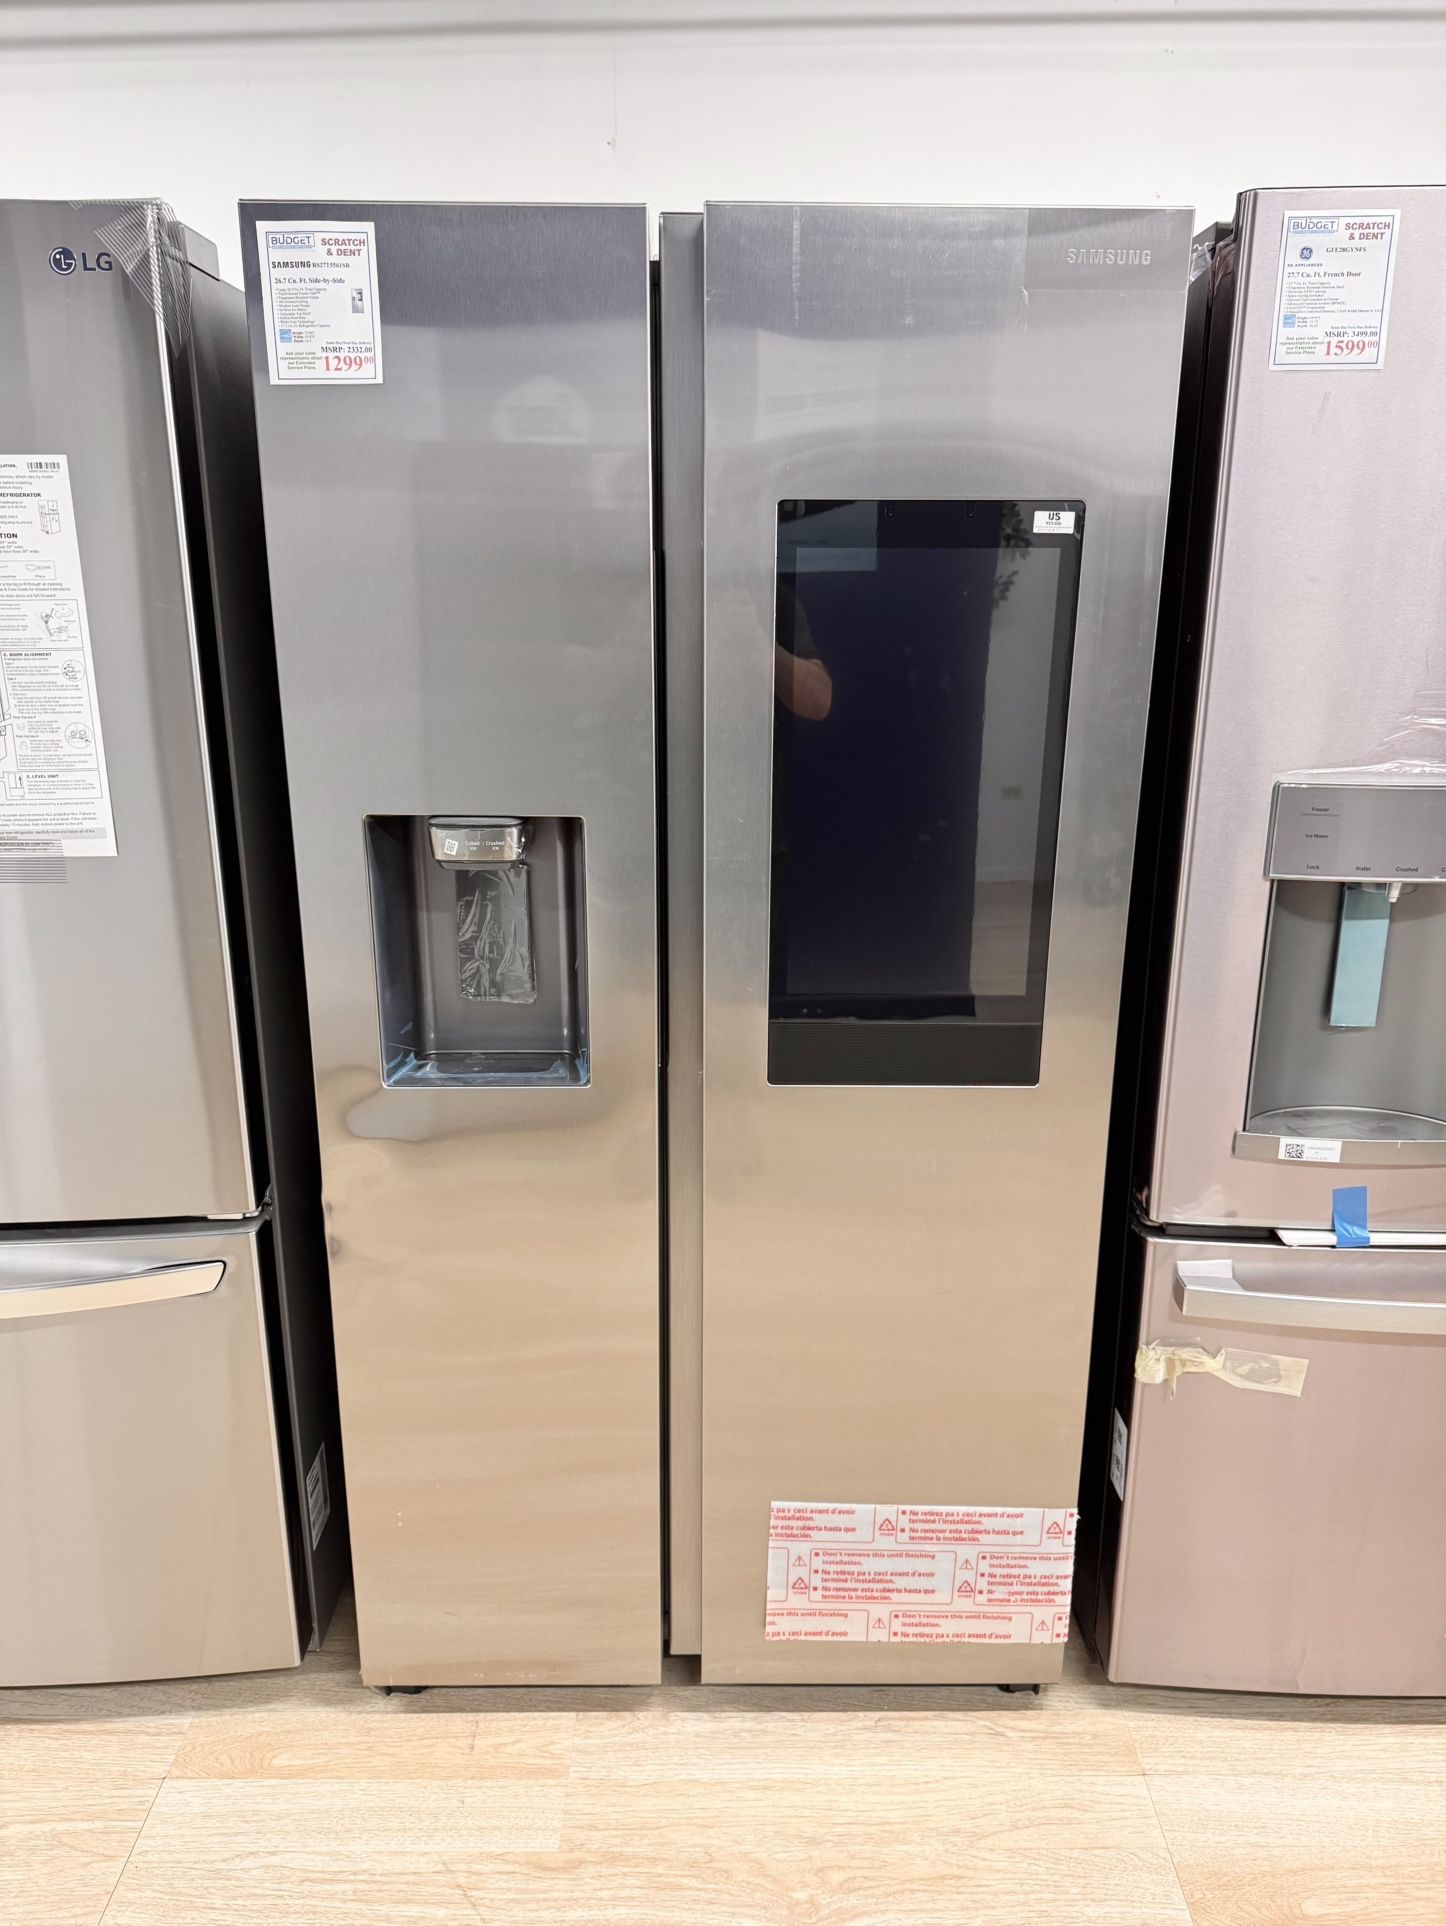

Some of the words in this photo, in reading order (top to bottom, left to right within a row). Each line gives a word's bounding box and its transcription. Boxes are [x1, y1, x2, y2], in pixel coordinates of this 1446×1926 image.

[1293, 219, 1336, 230] BUDGET
[1345, 222, 1390, 230] SCRATCH
[271, 234, 311, 245] BUDGET
[1359, 232, 1385, 240] DENT
[321, 238, 365, 246] SCRATCH
[327, 248, 333, 256] &
[1067, 249, 1151, 265] SAMSUNG
[82, 252, 112, 271] LG
[1325, 340, 1366, 356] 1599
[1368, 340, 1378, 348] 00
[324, 356, 363, 371] 1299
[364, 356, 374, 364] 00
[1048, 512, 1060, 520] US
[905, 1552, 936, 1560] finishing
[982, 1614, 1012, 1622] finishing
